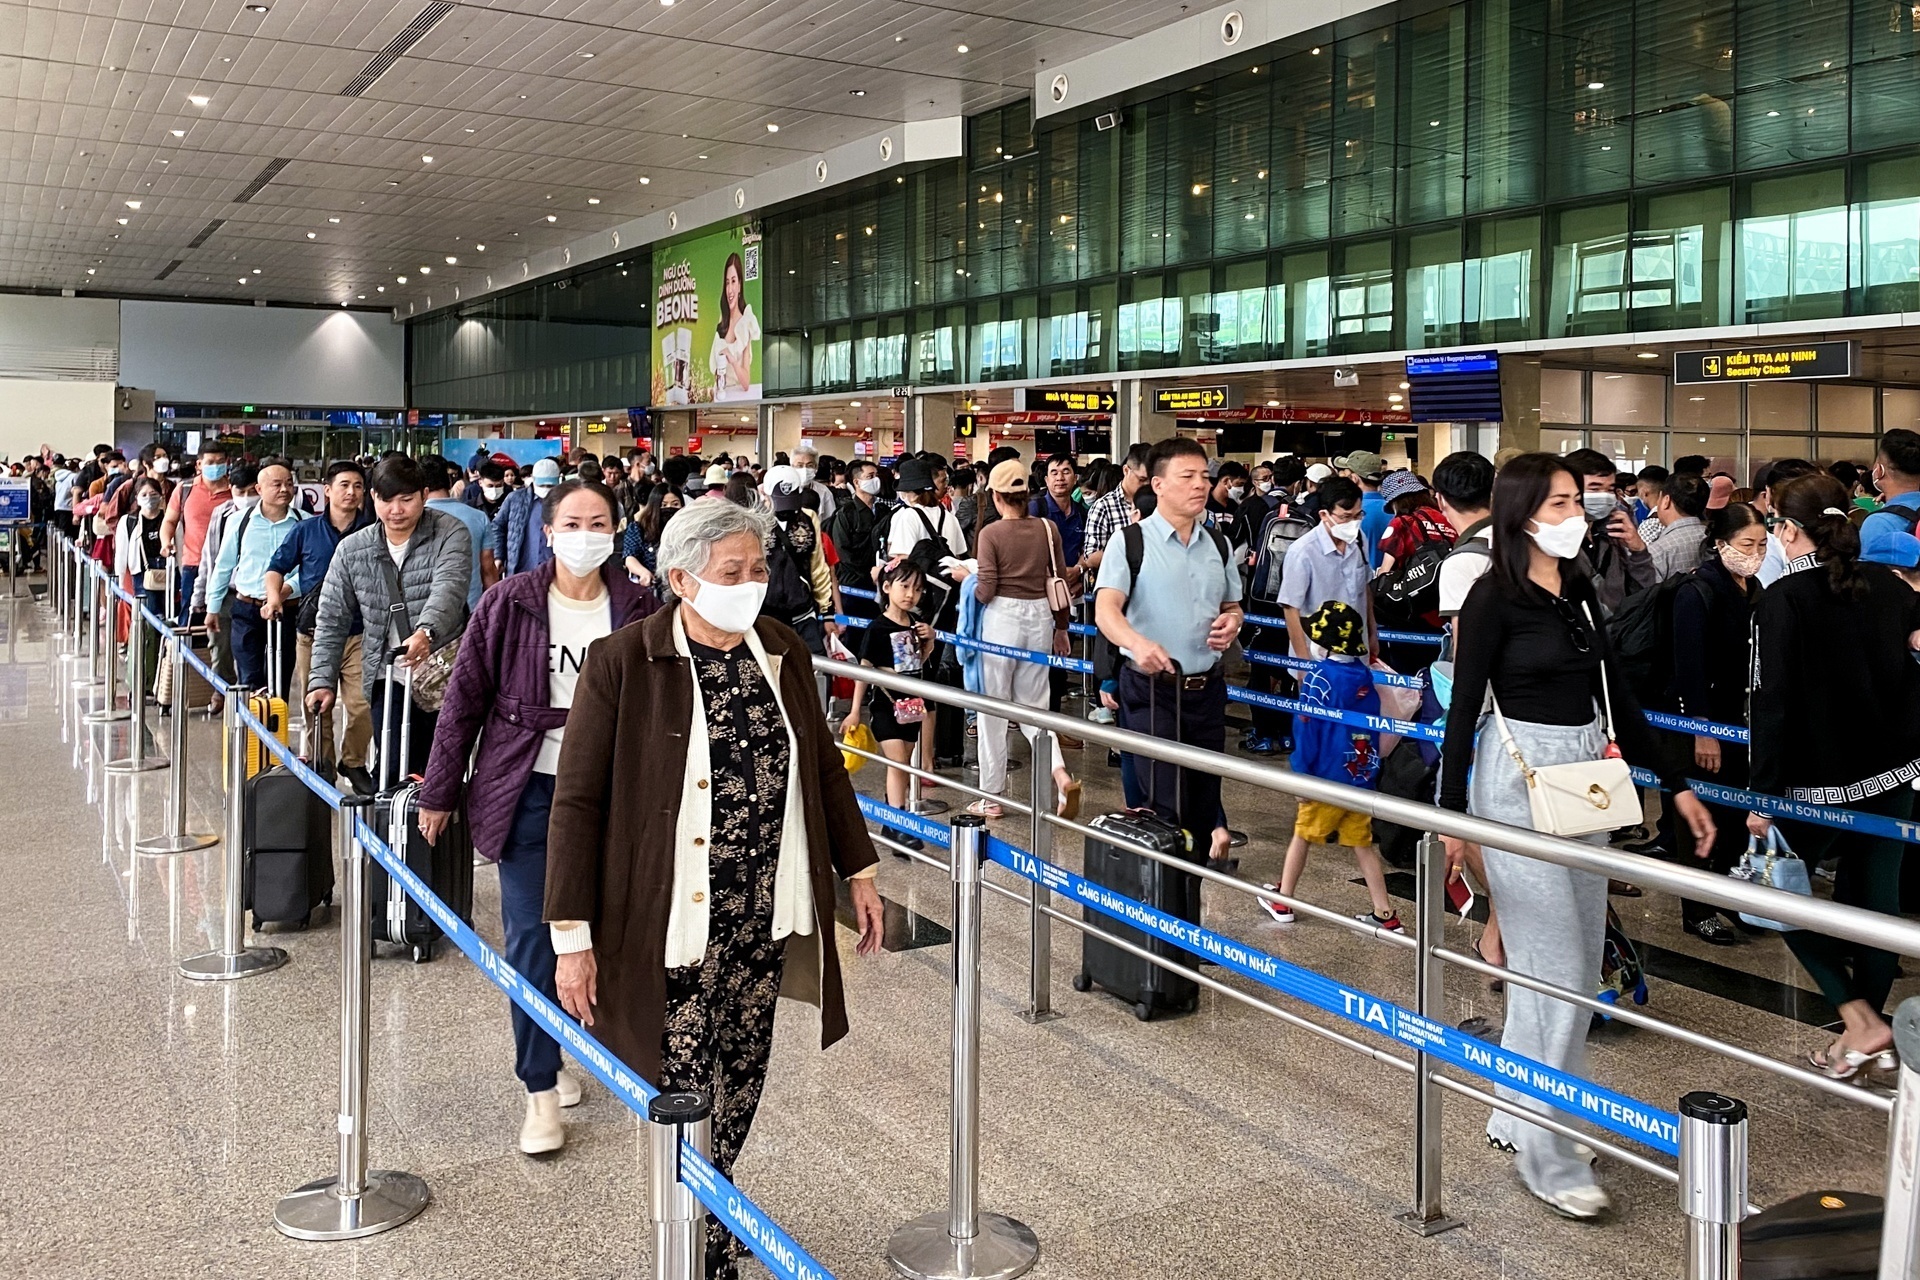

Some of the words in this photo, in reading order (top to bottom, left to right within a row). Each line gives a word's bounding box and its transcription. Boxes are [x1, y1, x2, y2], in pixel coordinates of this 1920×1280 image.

[657, 293, 699, 327] BEONE
[1726, 365, 1762, 377] Security
[1763, 364, 1791, 375] Check
[1753, 353, 1773, 364] TRA
[1774, 352, 1790, 363] AN
[1791, 350, 1817, 362] NINH
[961, 416, 972, 436] J
[1262, 409, 1275, 419] K-1
[1282, 409, 1295, 420] K-2
[1047, 655, 1063, 667] TIA
[1384, 673, 1407, 686] TIA
[1366, 715, 1390, 731] TIA
[1424, 727, 1438, 738] TAN
[1631, 767, 1652, 783] ẢNG
[1690, 783, 1719, 798] HÔNG
[1771, 799, 1793, 814] TÂN
[874, 805, 922, 833] INTERNATIONAL
[1895, 821, 1920, 840] TI
[1010, 850, 1038, 879] TIA
[1076, 881, 1100, 903] CẢNG
[1100, 891, 1125, 914] HÀNG
[1125, 904, 1158, 928] KHÔNG
[1158, 919, 1186, 941] QUỐC
[1187, 927, 1201, 947] TẾ
[1202, 934, 1222, 956] TÂN
[1224, 945, 1248, 964] SƠN
[1248, 956, 1278, 978] NHẤT
[478, 940, 498, 976] TIA
[1338, 988, 1389, 1031] TIA
[1397, 1010, 1411, 1022] TAN
[1411, 1016, 1425, 1028] SON
[1426, 1022, 1444, 1036] NHAT
[522, 984, 534, 1006] TAN
[534, 996, 547, 1018] SON
[547, 1006, 563, 1033] NHAT
[563, 1022, 615, 1080] INTERNATIONAL
[614, 1068, 648, 1108] AIRPORT
[1397, 1020, 1448, 1048] INTERNATIONAL
[1397, 1030, 1426, 1048] AIRPORT
[1462, 1042, 1492, 1069] TAN
[1495, 1055, 1530, 1084] SON
[1532, 1070, 1578, 1103] NHAT
[1581, 1090, 1679, 1145] INTERNATI
[680, 1153, 718, 1196] INTERNATIONAL
[727, 1196, 759, 1239] CẢNG
[760, 1226, 796, 1274] HÀNG
